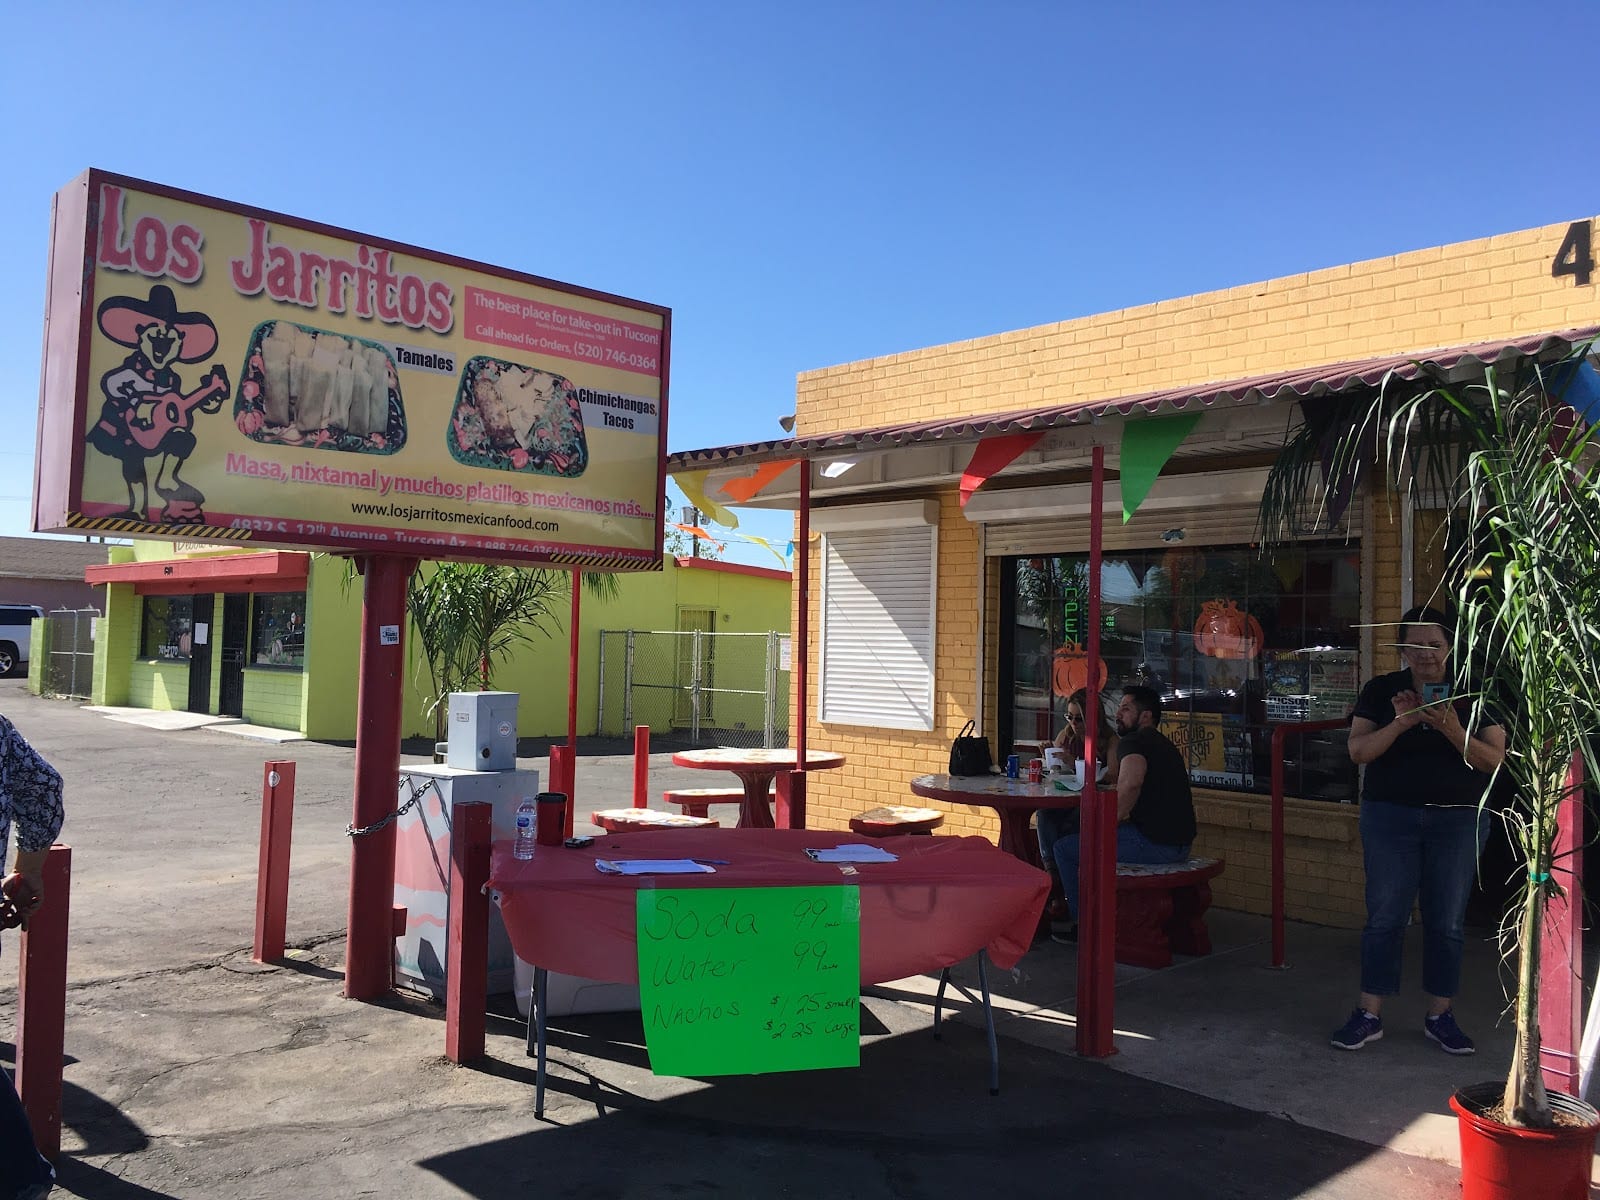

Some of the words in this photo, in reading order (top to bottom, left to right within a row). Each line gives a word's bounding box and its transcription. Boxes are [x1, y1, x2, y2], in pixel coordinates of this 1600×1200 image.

[99, 184, 202, 281] Los
[231, 218, 453, 332] Jarritos
[1552, 220, 1595, 287] 4
[473, 292, 495, 309] The
[496, 300, 521, 315] best
[522, 304, 551, 321] place
[552, 310, 568, 324] for
[569, 313, 612, 335] take-out
[612, 324, 622, 337] in
[623, 326, 659, 345] Tucson!
[395, 346, 454, 372] Tamales
[475, 324, 494, 336] Call
[495, 327, 524, 343] ahead
[525, 333, 538, 346] for
[573, 341, 603, 360] (520)
[605, 348, 656, 370] 746-0364
[578, 388, 657, 417] Chimichangas,
[603, 411, 634, 430] Tacos
[225, 452, 288, 482] Masa,
[291, 460, 378, 490] nixtamal
[379, 474, 392, 495] y
[394, 475, 463, 498] muchos
[466, 480, 529, 505] platillos
[532, 492, 610, 514] mexicanos
[230, 518, 273, 532] 4832
[329, 526, 389, 541] Avenue
[394, 531, 446, 546] Tucson
[352, 502, 559, 532] www.losjarritosmexicanfood.com
[1064, 587, 1078, 645] OPEN
[644, 896, 758, 940] Soda
[793, 899, 828, 929] 99
[652, 952, 748, 987] Water
[793, 940, 828, 972] 99
